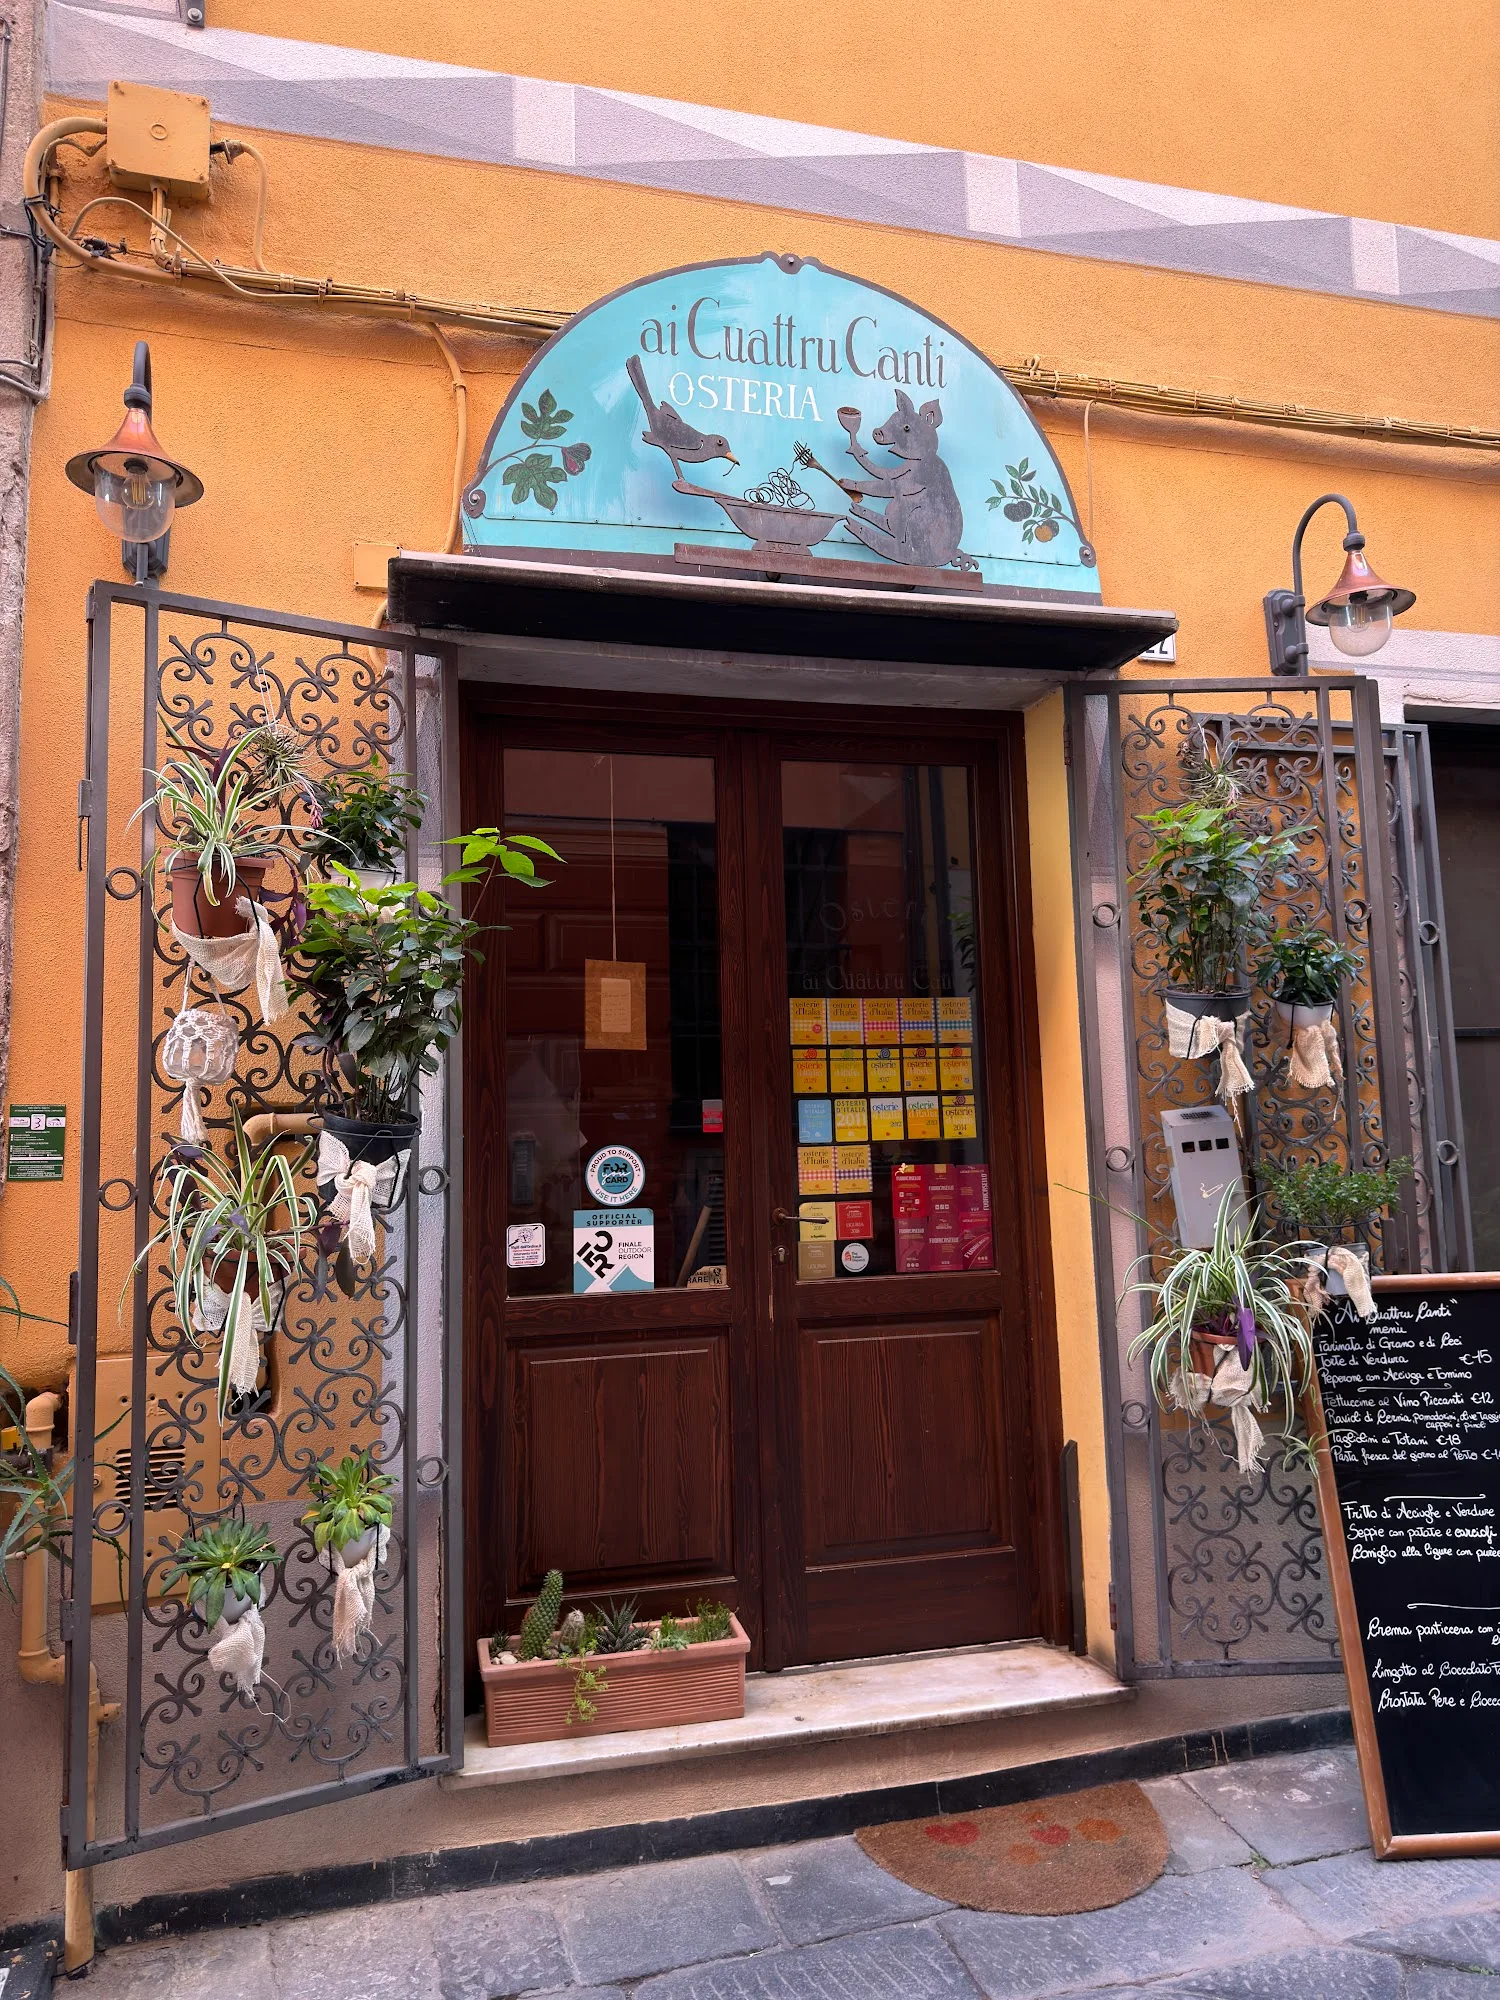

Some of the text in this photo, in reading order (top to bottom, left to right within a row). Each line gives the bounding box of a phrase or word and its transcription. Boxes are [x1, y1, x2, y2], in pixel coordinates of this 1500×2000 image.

[639, 297, 949, 388] ai Cuattru Canti
[668, 371, 823, 422] OSTERIA
[872, 1102, 898, 1112] osterie
[908, 1102, 934, 1110] osterie
[945, 1107, 972, 1116] osterie
[836, 1113, 868, 1126] 2011
[590, 1152, 606, 1173] PROUD
[618, 1150, 640, 1172] SUPPORT
[804, 1156, 829, 1165] d'Italia
[602, 1171, 631, 1186] you
[606, 1176, 628, 1184] CARD
[596, 1188, 610, 1202] USE
[619, 1186, 638, 1202] HERE
[1335, 1300, 1360, 1324] Ai
[1369, 1322, 1407, 1334] menù
[1318, 1334, 1364, 1352] Farinata
[1366, 1338, 1376, 1350] di
[1379, 1336, 1415, 1350] Grano
[1426, 1336, 1436, 1347] di
[1440, 1332, 1463, 1349] Ceci
[1315, 1350, 1492, 1367] Torte di Verdura €15
[1317, 1367, 1363, 1388] Peperone
[1365, 1373, 1381, 1381] con
[1383, 1368, 1425, 1385] Acciuga
[1430, 1367, 1472, 1380] Tomino
[1321, 1391, 1494, 1408] Fettuccine al Vino Piccanti €12
[1324, 1408, 1361, 1426] Ravioli
[1364, 1410, 1374, 1423] di
[1460, 1410, 1478, 1421] olive
[1426, 1421, 1453, 1432] capperi
[1463, 1421, 1486, 1432] pinoli
[1382, 1435, 1391, 1444] ai
[1389, 1432, 1428, 1446] Totani
[1435, 1434, 1462, 1446] €18
[1330, 1445, 1359, 1462] Pasta
[1361, 1449, 1390, 1465] fresca
[1392, 1449, 1408, 1460] del
[1410, 1450, 1436, 1462] giorno
[1438, 1450, 1448, 1459] al
[1450, 1447, 1478, 1460] Pesto
[1341, 1501, 1378, 1520] Fritto
[1381, 1506, 1391, 1518] di
[1396, 1502, 1441, 1524] Acciughe
[1452, 1502, 1495, 1517] Verdure
[1347, 1523, 1384, 1542] Seppie
[1407, 1526, 1442, 1542] patate
[1446, 1528, 1452, 1536] e
[1454, 1525, 1498, 1544] carciofi
[1351, 1544, 1397, 1564] Coniglio
[1402, 1546, 1422, 1557] alla
[1424, 1543, 1452, 1560] ligure
[1367, 1617, 1412, 1640] Crema
[1416, 1621, 1473, 1642] pasticcera
[1478, 1626, 1494, 1634] con
[1372, 1658, 1417, 1683] Lingotto
[1422, 1663, 1435, 1676] al
[1439, 1661, 1492, 1679] Cioccolato
[1378, 1688, 1426, 1712] Crostata
[1428, 1688, 1456, 1708] Pere
[1460, 1698, 1466, 1706] e
